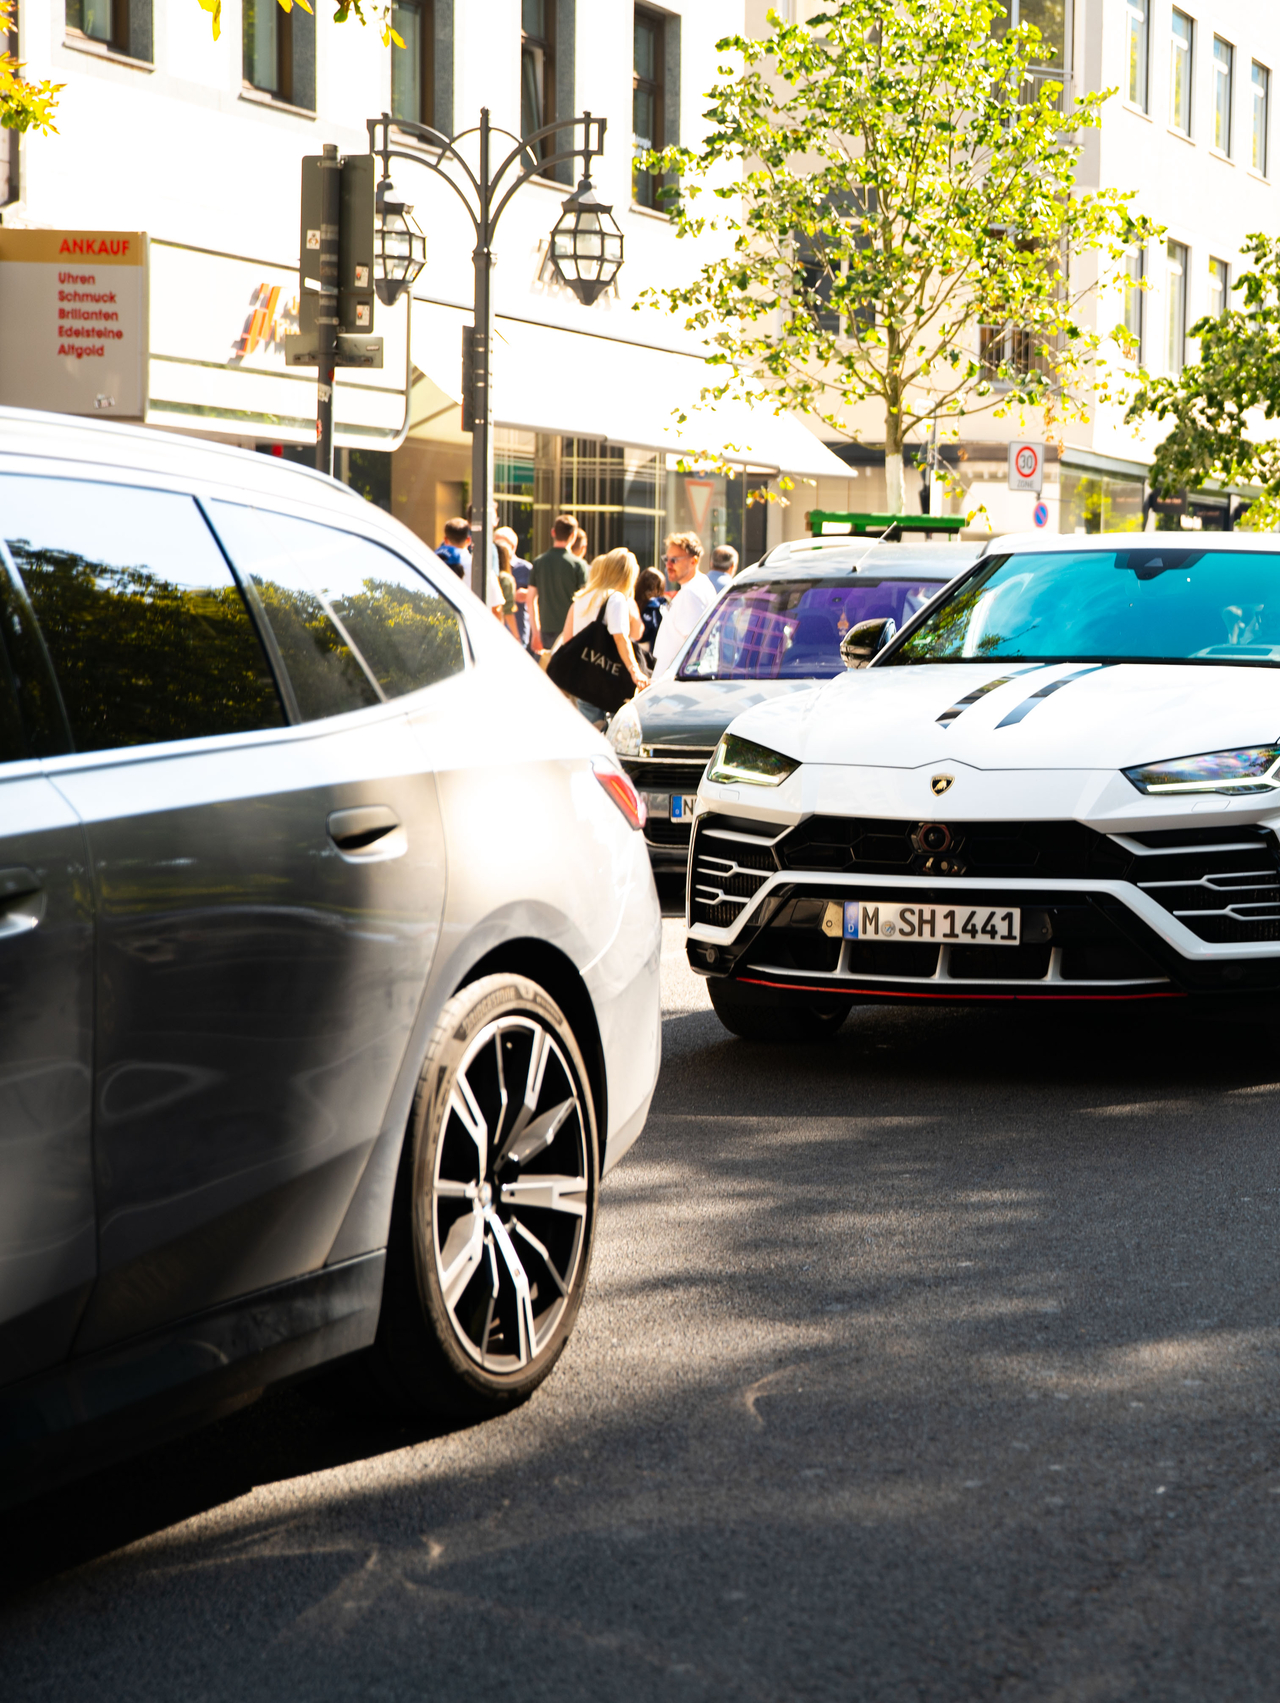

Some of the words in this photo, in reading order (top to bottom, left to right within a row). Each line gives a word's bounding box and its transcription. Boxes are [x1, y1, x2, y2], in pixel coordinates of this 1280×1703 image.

[59, 238, 130, 256] ANKAUF
[58, 272, 95, 285] Uhren
[58, 290, 117, 304] Schmuck
[58, 308, 119, 321] Brillanten
[57, 325, 124, 340] Edelsteine
[57, 344, 105, 359] Altgold
[1020, 454, 1033, 469] 30
[1017, 480, 1034, 489] ZONE
[861, 906, 880, 936] M
